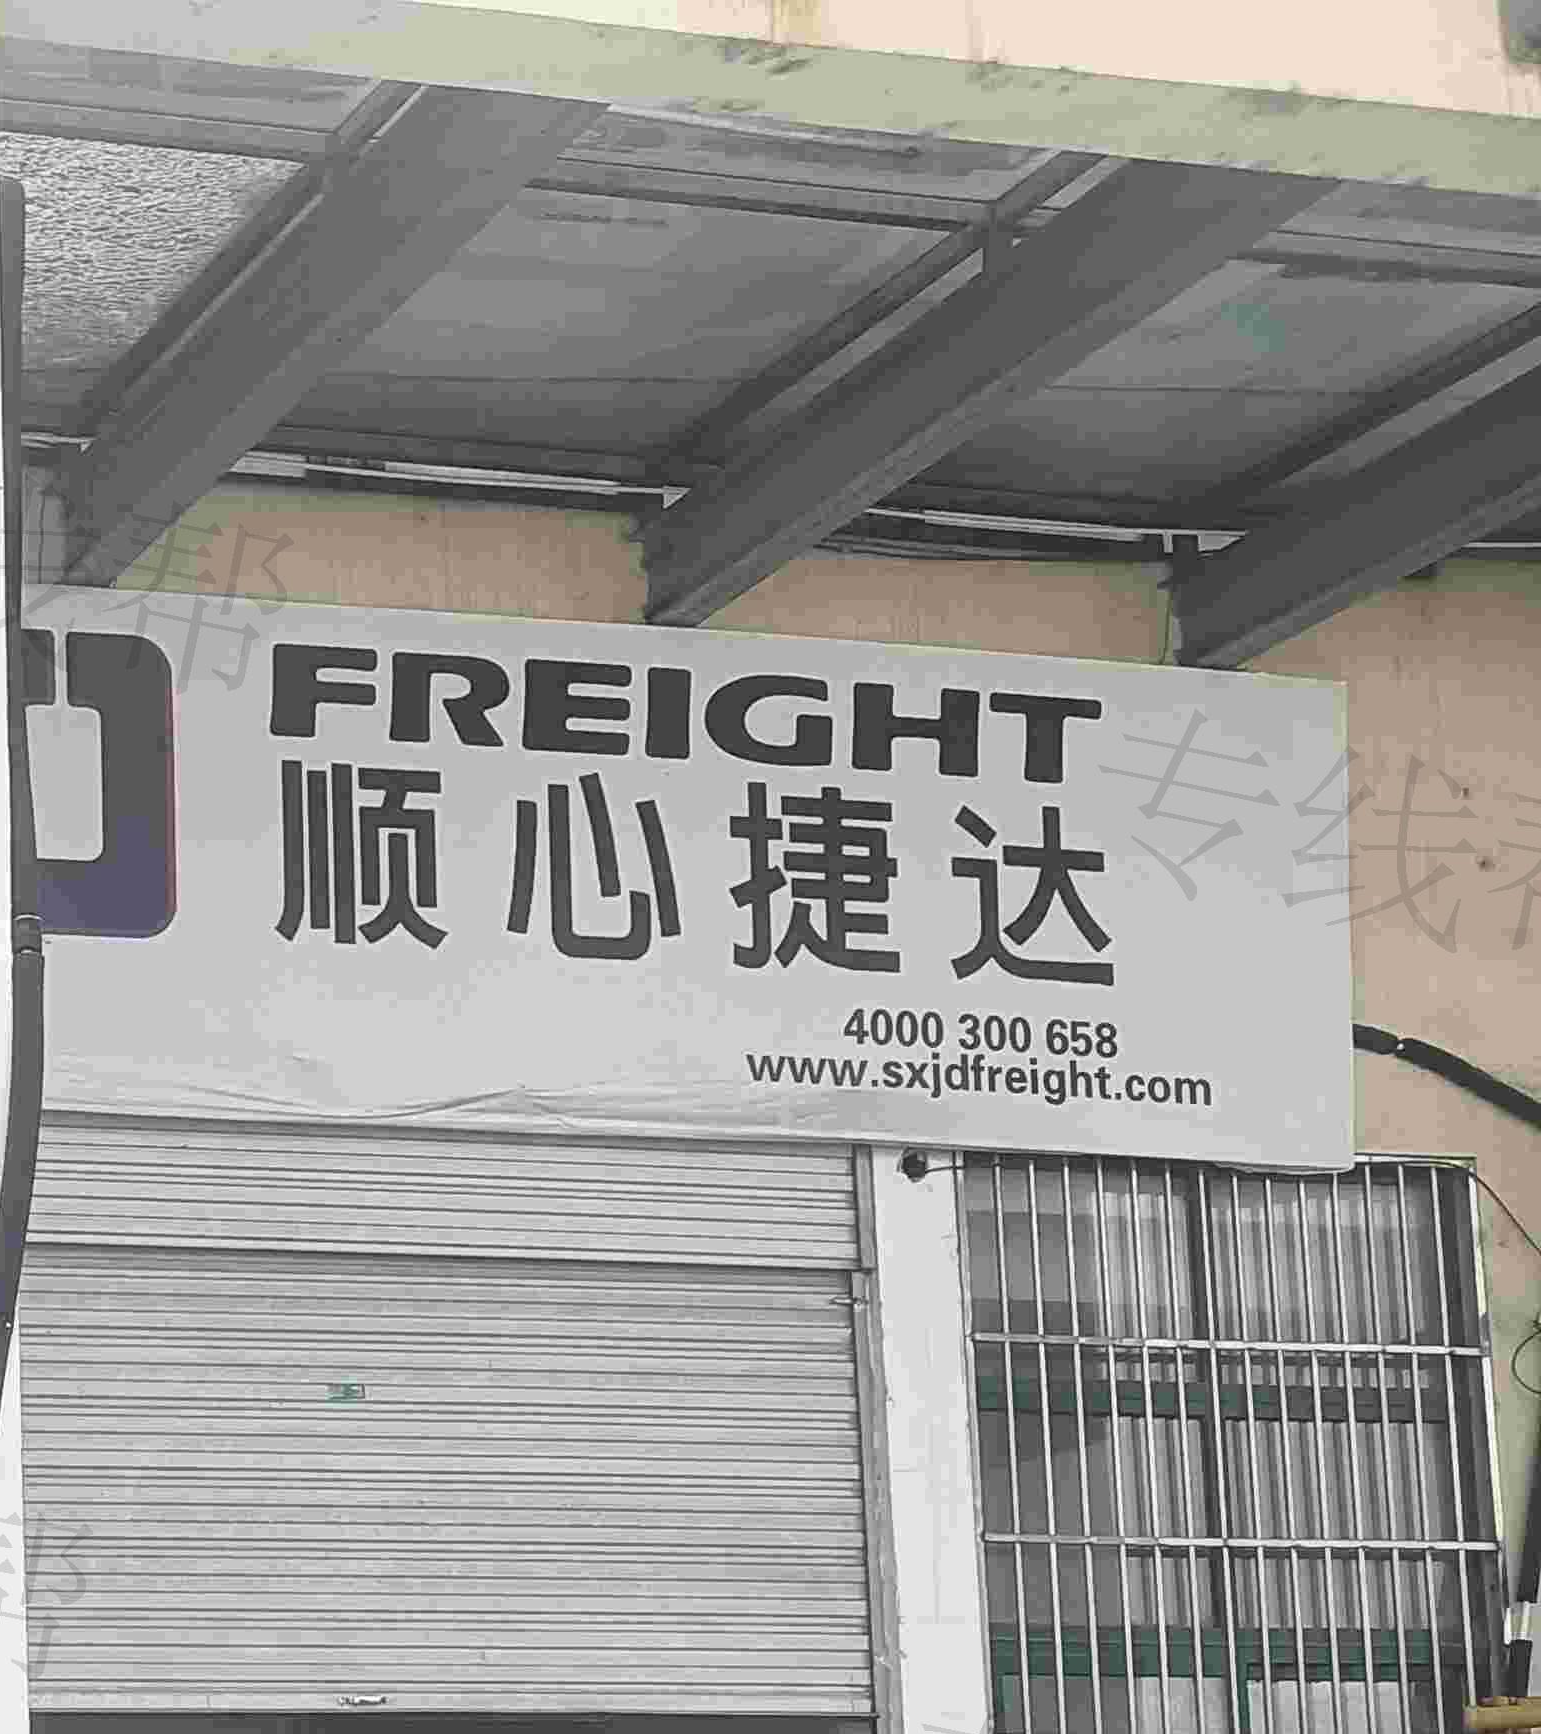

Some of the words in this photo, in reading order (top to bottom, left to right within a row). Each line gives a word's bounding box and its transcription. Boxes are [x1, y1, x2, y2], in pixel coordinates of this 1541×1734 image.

[269, 643, 1103, 784] FREIGHT
[274, 758, 1115, 986] 顺心捷达
[746, 1050, 1213, 1107] www.sxjdfreight.com
[843, 1007, 945, 1050] 4000
[957, 1012, 1033, 1054] 300
[1044, 1016, 1120, 1060] 658
